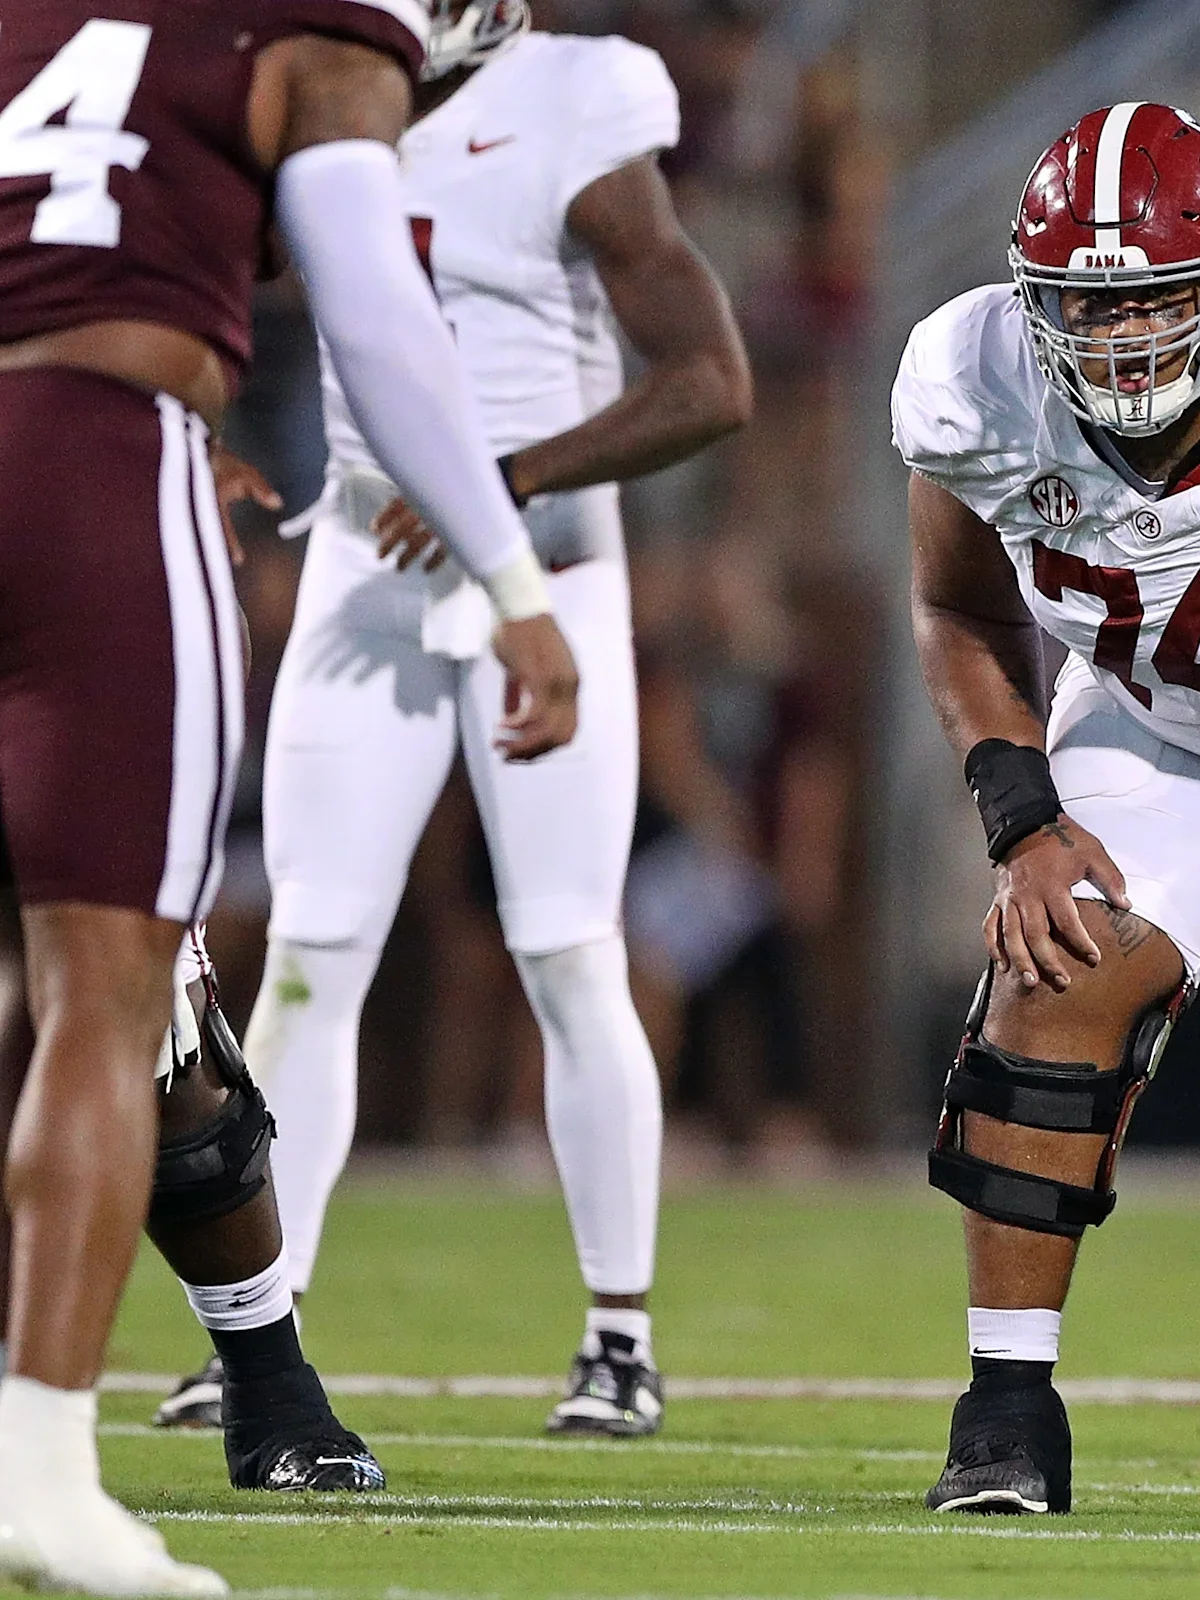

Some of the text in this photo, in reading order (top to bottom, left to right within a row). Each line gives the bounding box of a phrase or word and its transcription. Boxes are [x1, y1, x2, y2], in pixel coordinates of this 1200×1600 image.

[0, 17, 153, 249] 4
[1085, 254, 1126, 268] BAMA
[1031, 477, 1078, 527] SEC
